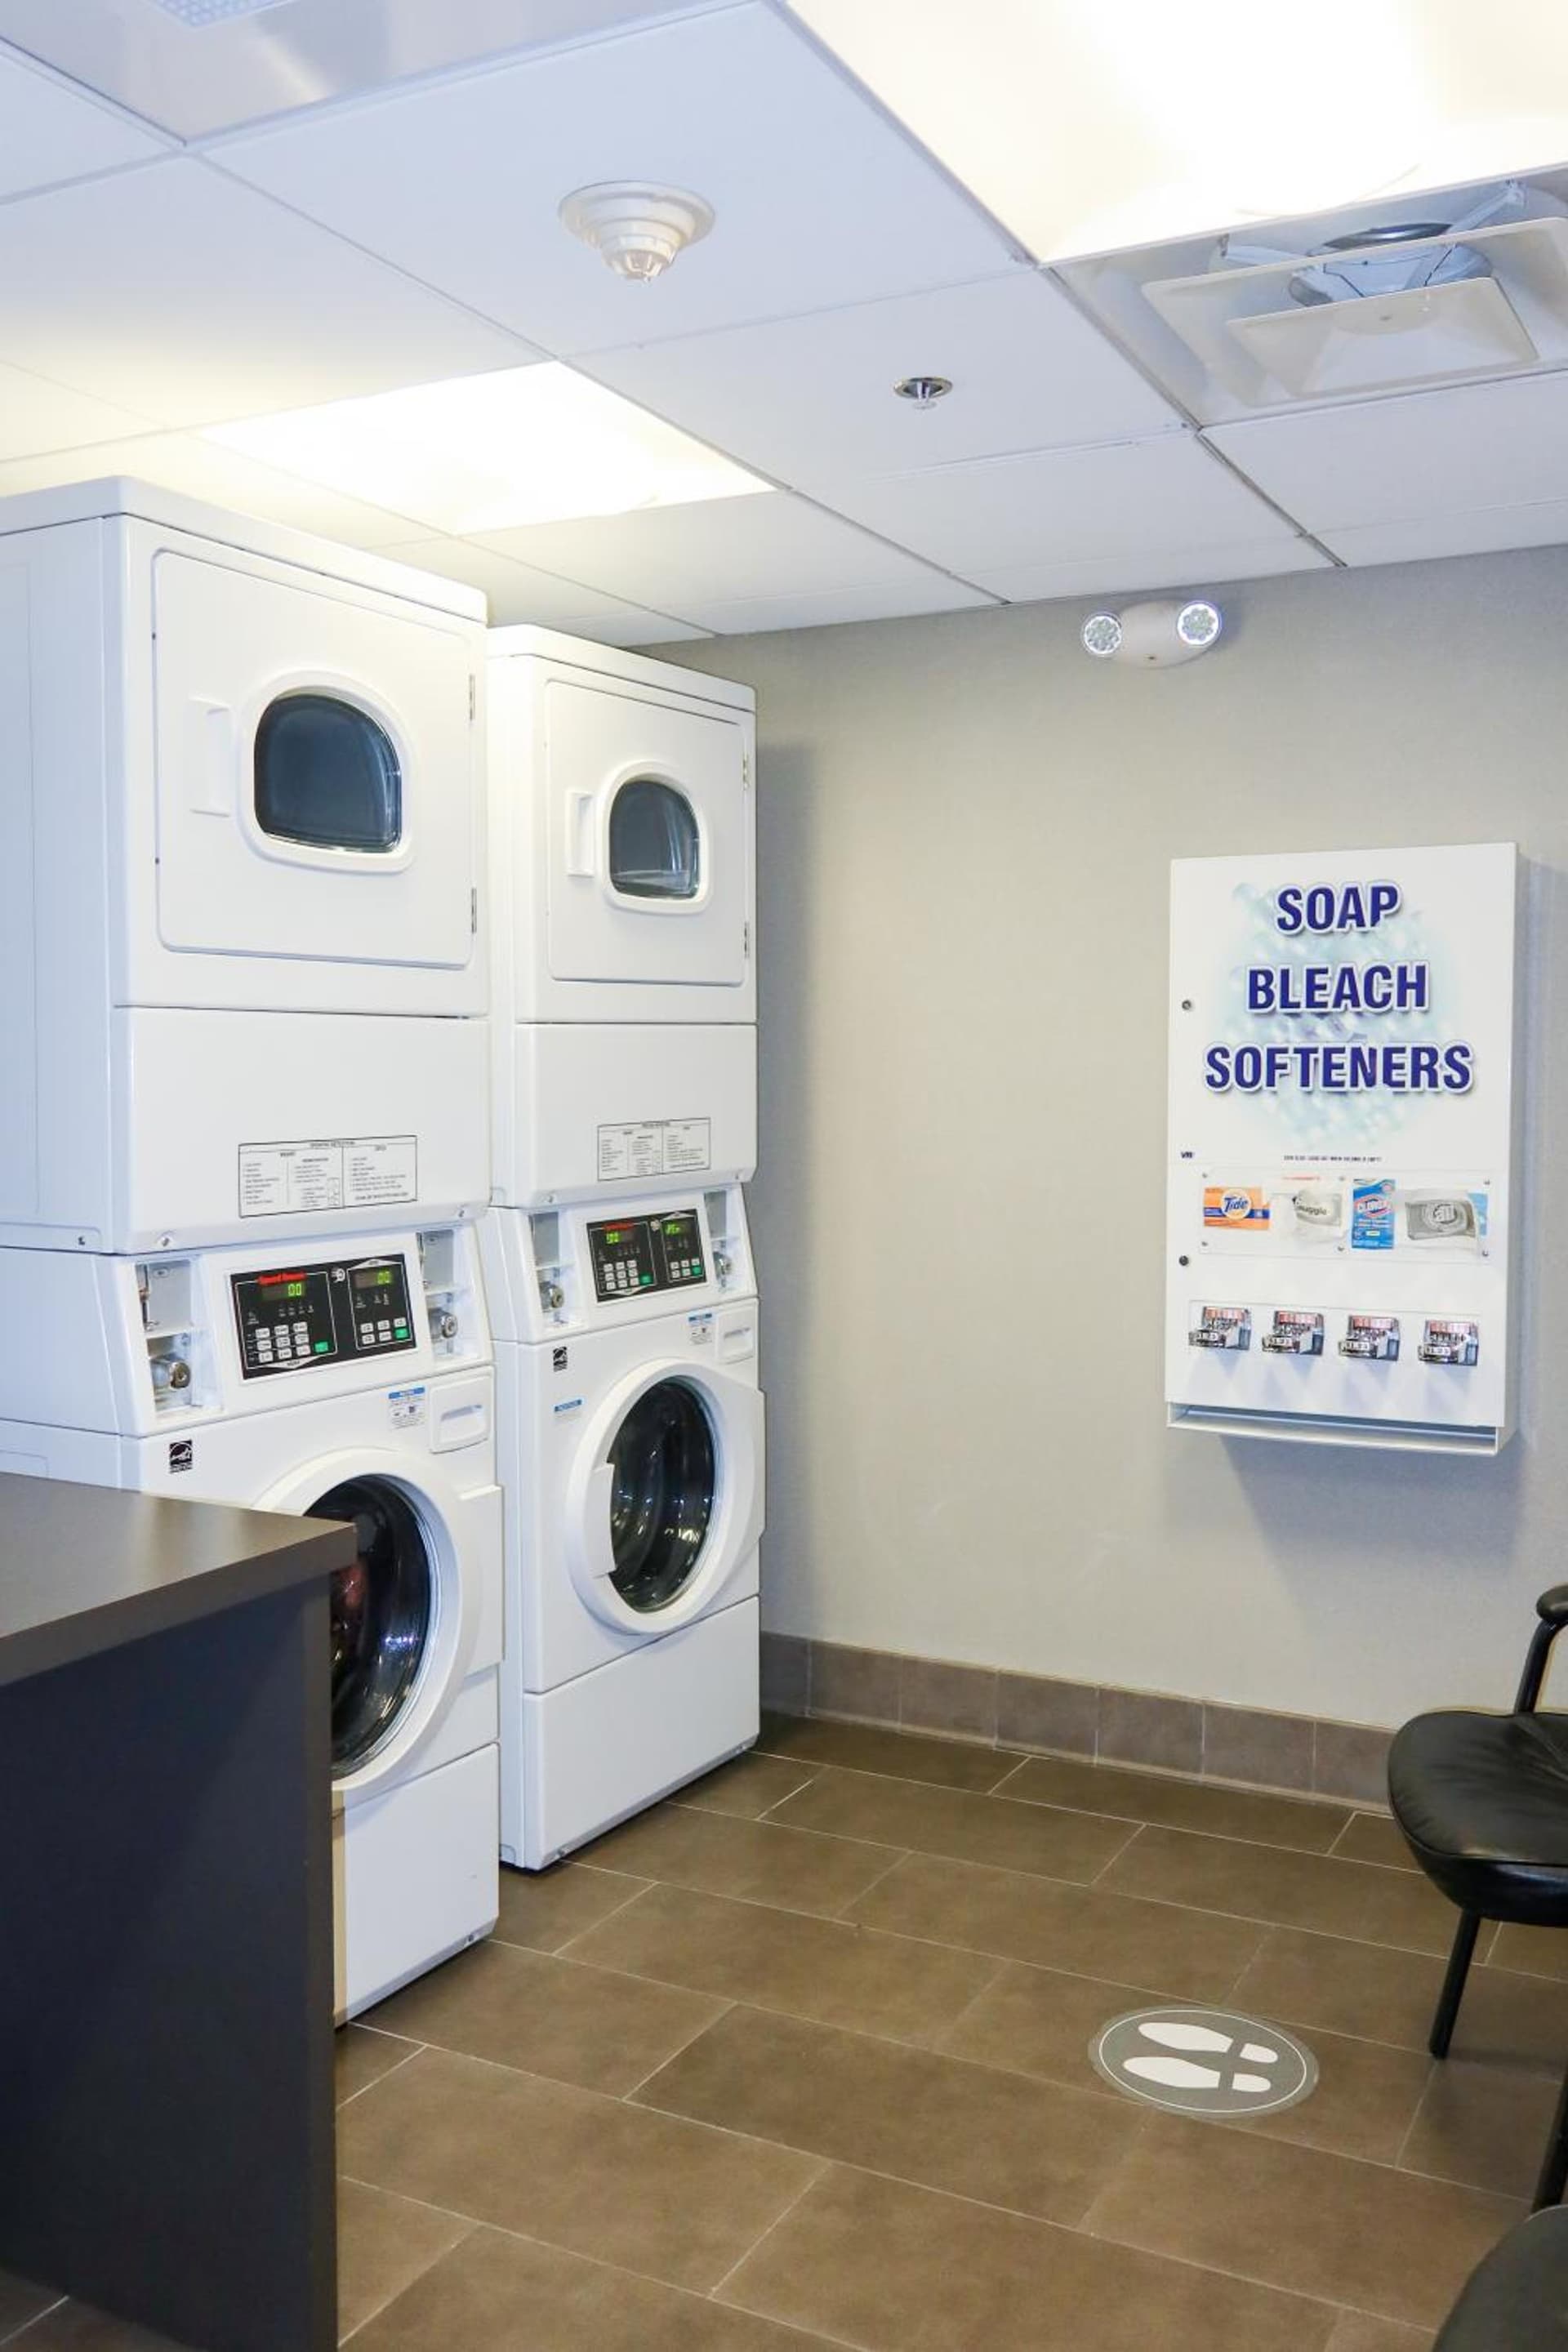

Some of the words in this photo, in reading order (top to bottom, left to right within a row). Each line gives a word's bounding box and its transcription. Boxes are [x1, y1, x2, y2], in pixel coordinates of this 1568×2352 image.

[1276, 884, 1400, 931] SOAP
[1247, 964, 1427, 1010] BLEACH
[1205, 1045, 1472, 1090] SOFTENERS
[1223, 1196, 1249, 1213] Tide
[1433, 1203, 1455, 1222] all
